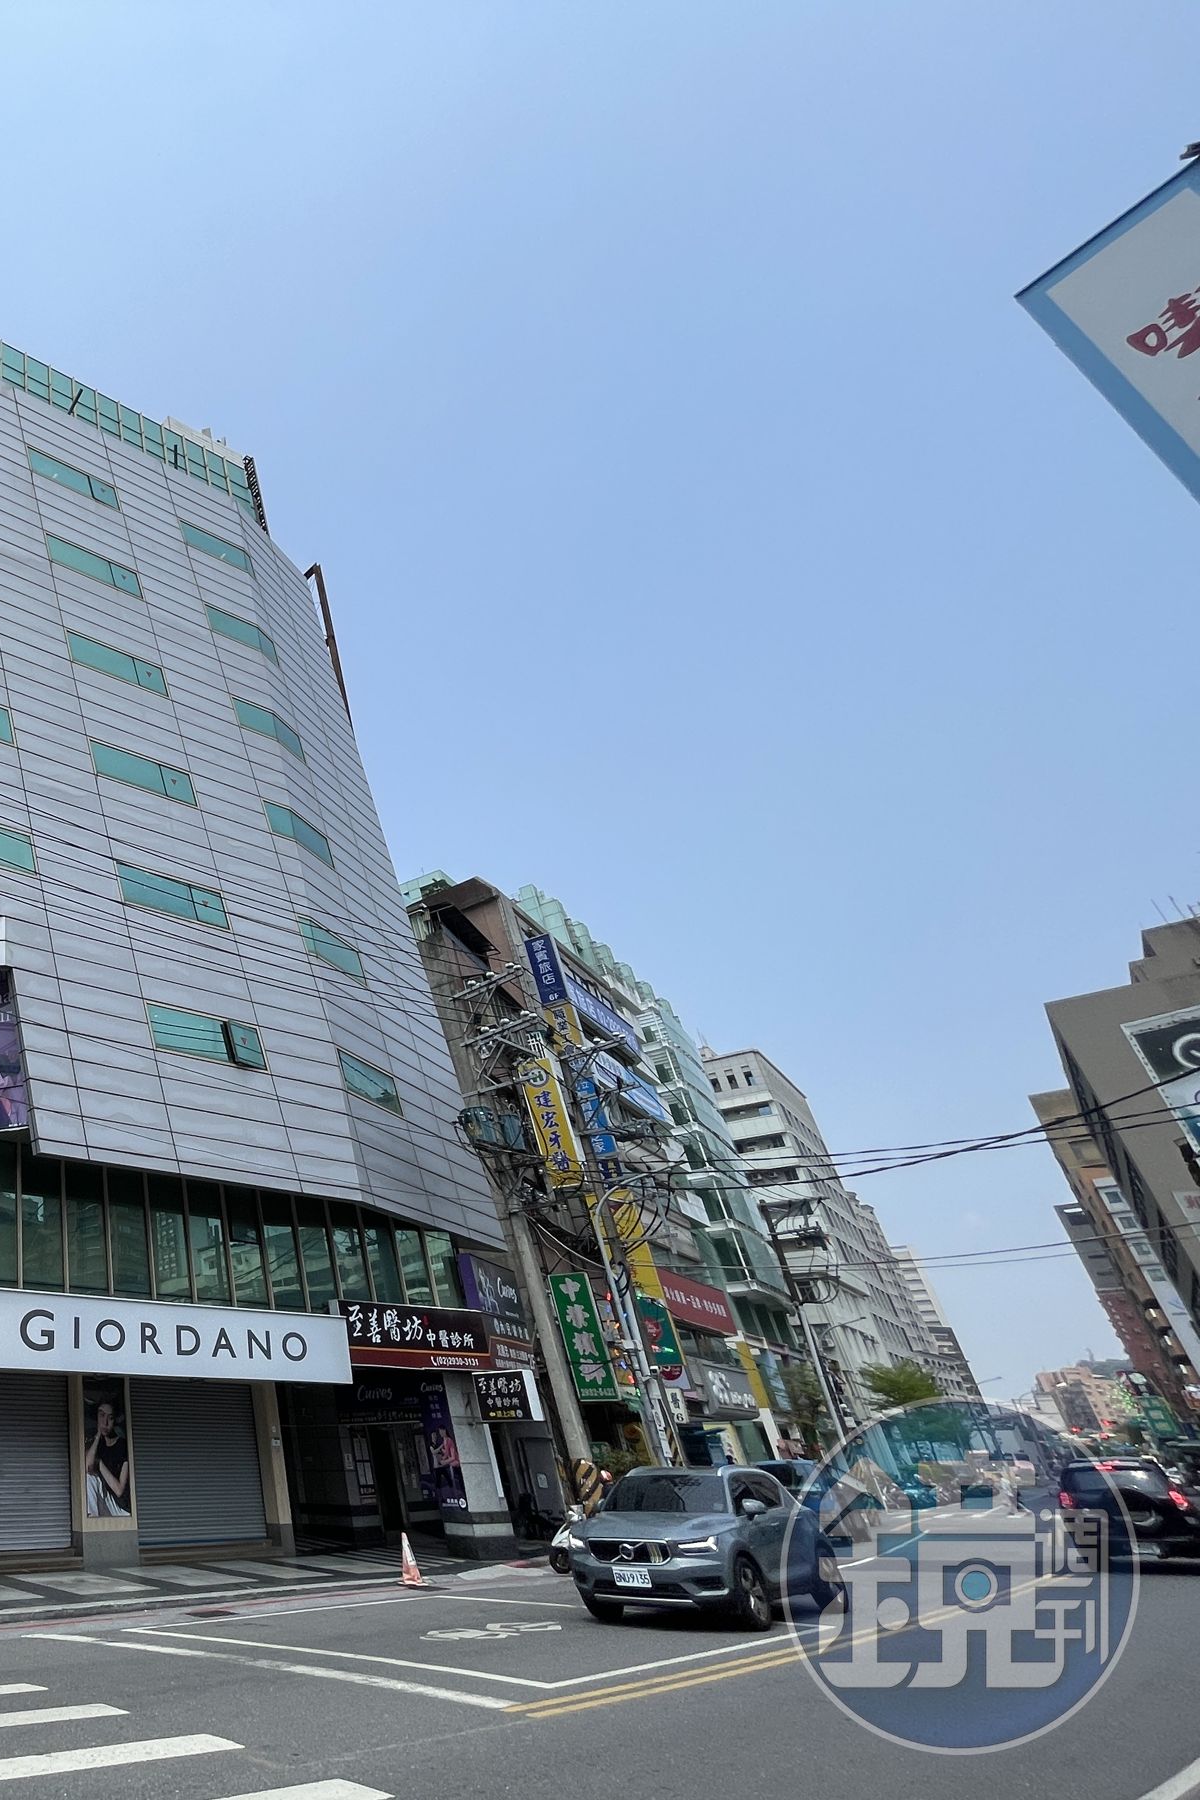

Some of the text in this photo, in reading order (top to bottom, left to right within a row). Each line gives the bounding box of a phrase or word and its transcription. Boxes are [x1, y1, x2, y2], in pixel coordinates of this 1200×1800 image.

[534, 1090, 571, 1171] 建宏牙醫
[19, 1308, 308, 1362] GIORDANO
[348, 1304, 423, 1343] 至善醫坊
[426, 1329, 474, 1349] 中醫診所
[478, 1377, 521, 1395] 至善醫坊
